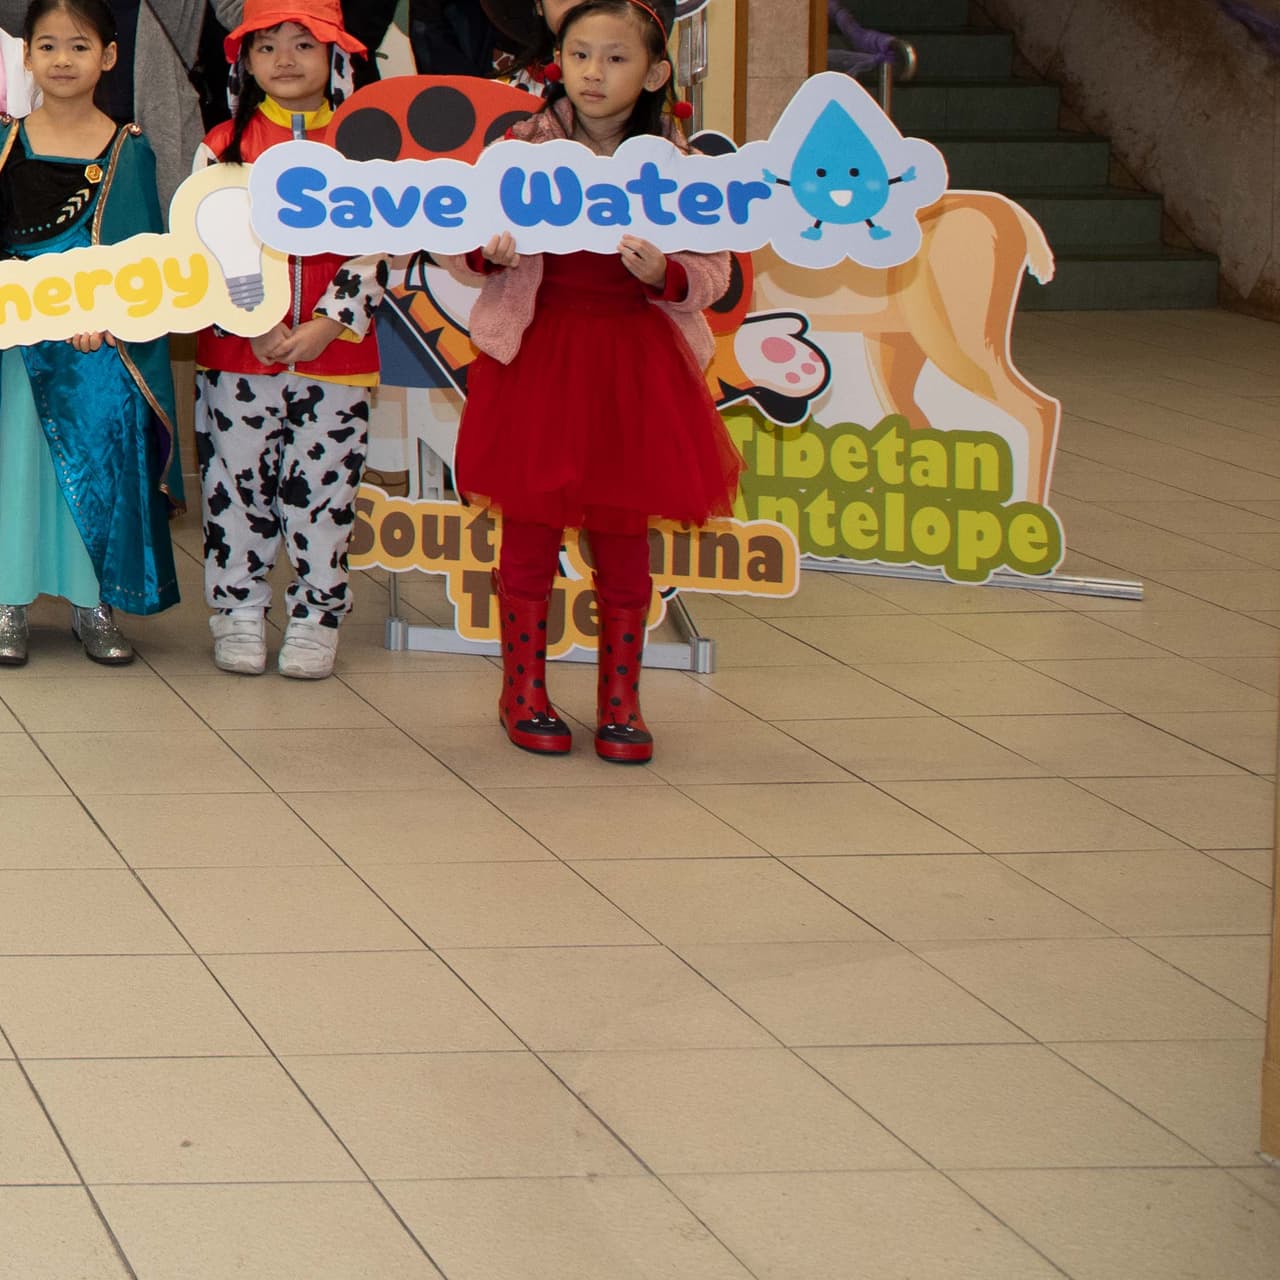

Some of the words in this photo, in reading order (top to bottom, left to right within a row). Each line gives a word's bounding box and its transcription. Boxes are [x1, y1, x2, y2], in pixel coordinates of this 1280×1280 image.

[276, 166, 468, 229] Save
[500, 162, 772, 227] Water
[347, 497, 496, 563] Sout
[733, 487, 1050, 571] ntelope
